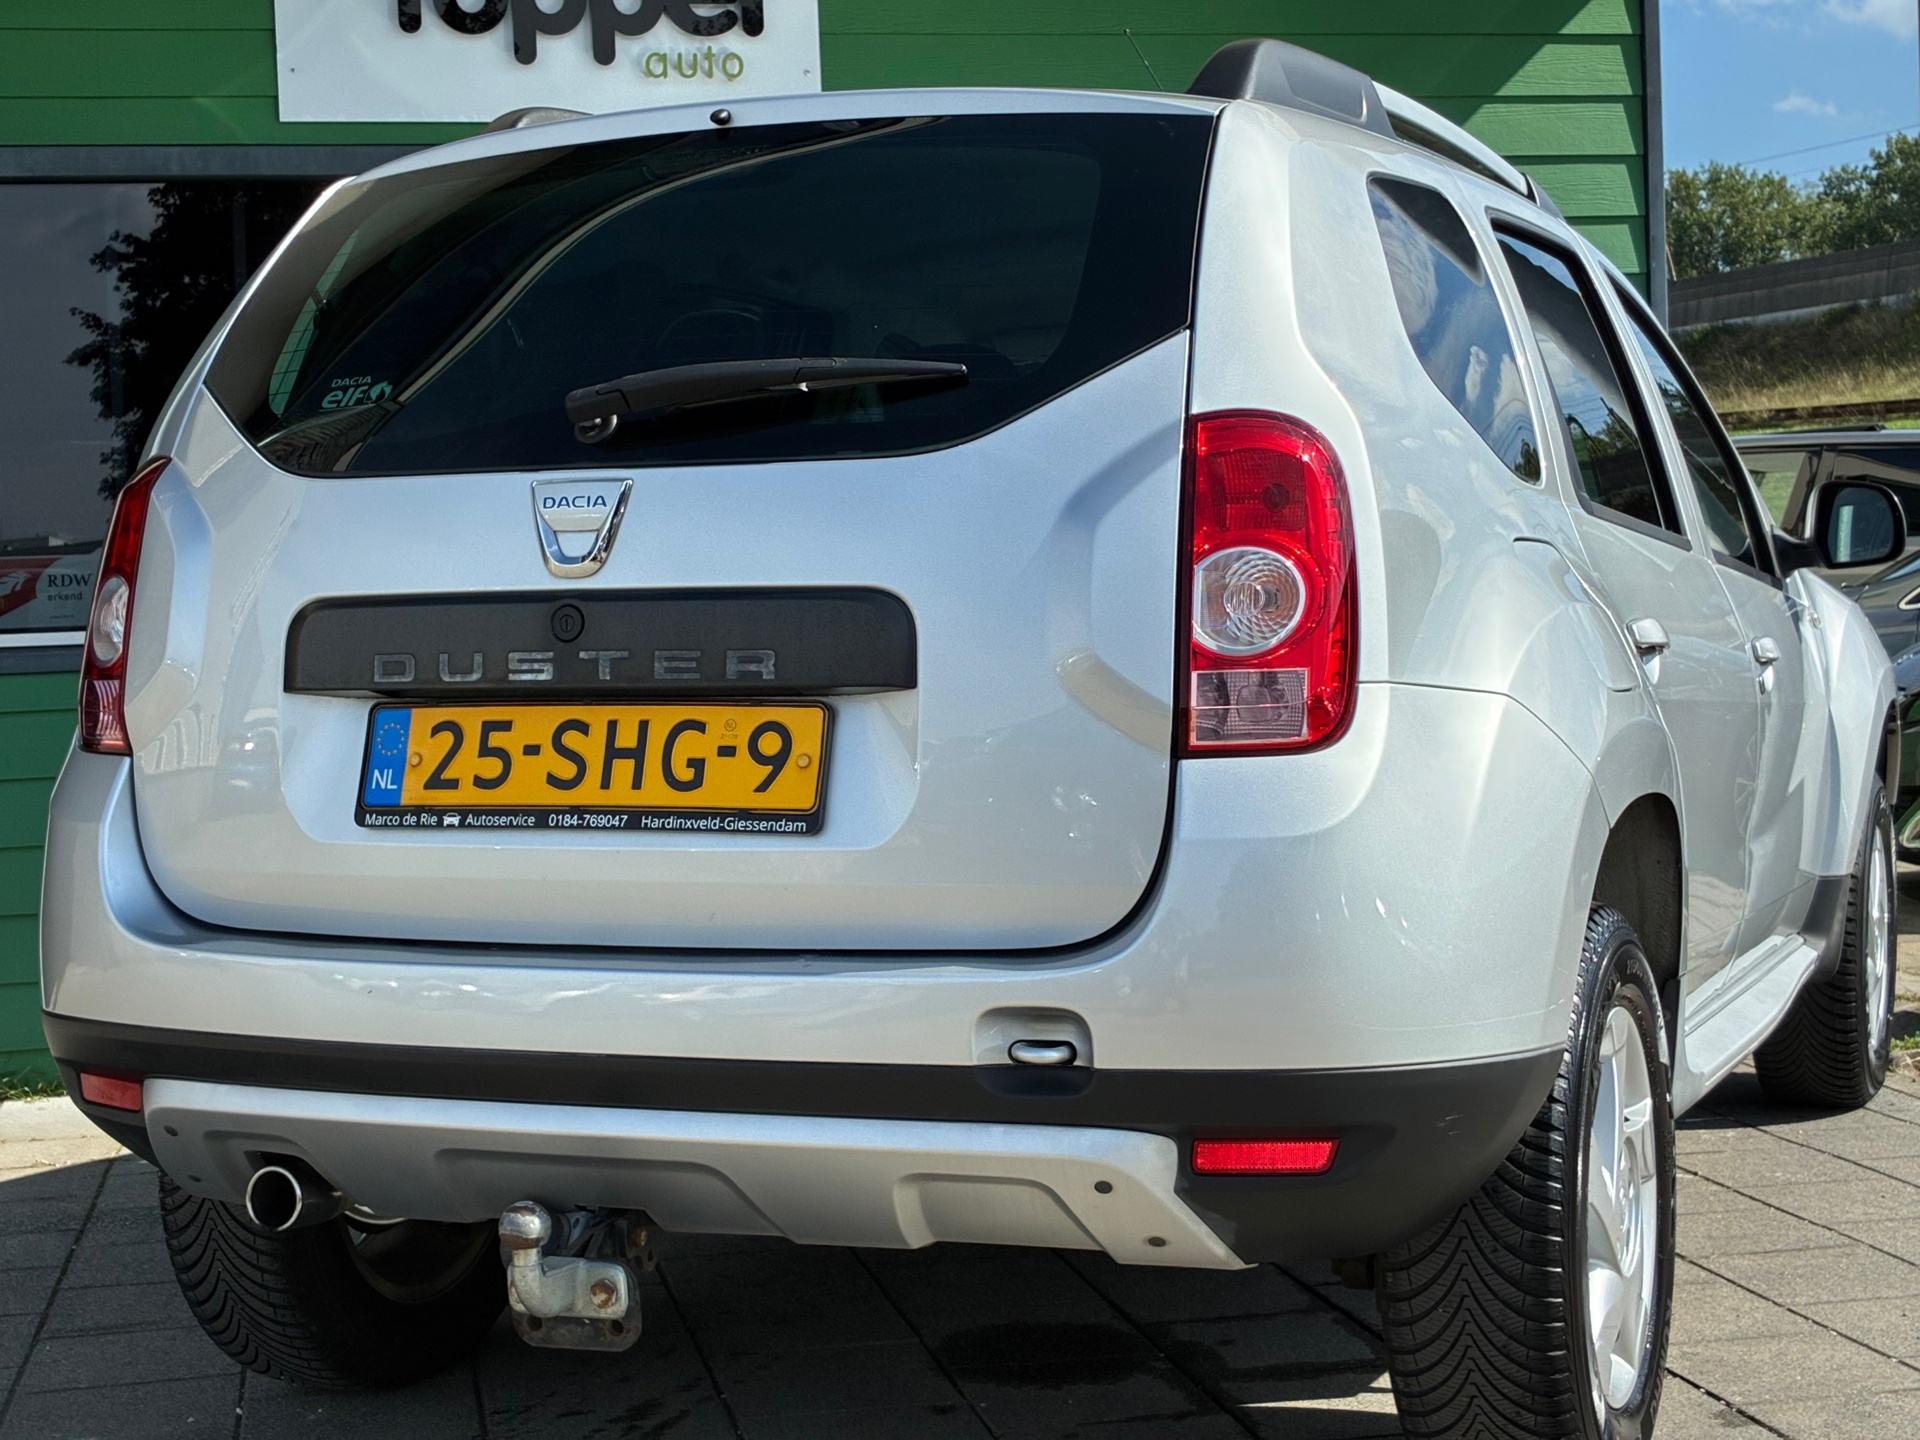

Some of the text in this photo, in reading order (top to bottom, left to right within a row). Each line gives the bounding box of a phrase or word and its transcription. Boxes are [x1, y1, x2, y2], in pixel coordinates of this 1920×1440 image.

[645, 45, 744, 79] auto
[331, 376, 371, 387] DACIA
[321, 386, 368, 408] elf
[543, 495, 607, 509] DACIA
[47, 574, 92, 588] RDW
[47, 592, 83, 601] erkend
[373, 650, 776, 683] DUSTER
[423, 719, 793, 793] 25-SHG-9
[371, 769, 398, 790] NL
[365, 813, 807, 832] Marco de Rie Autoservice 0184-769047 Hardinxveld-Giessendam
